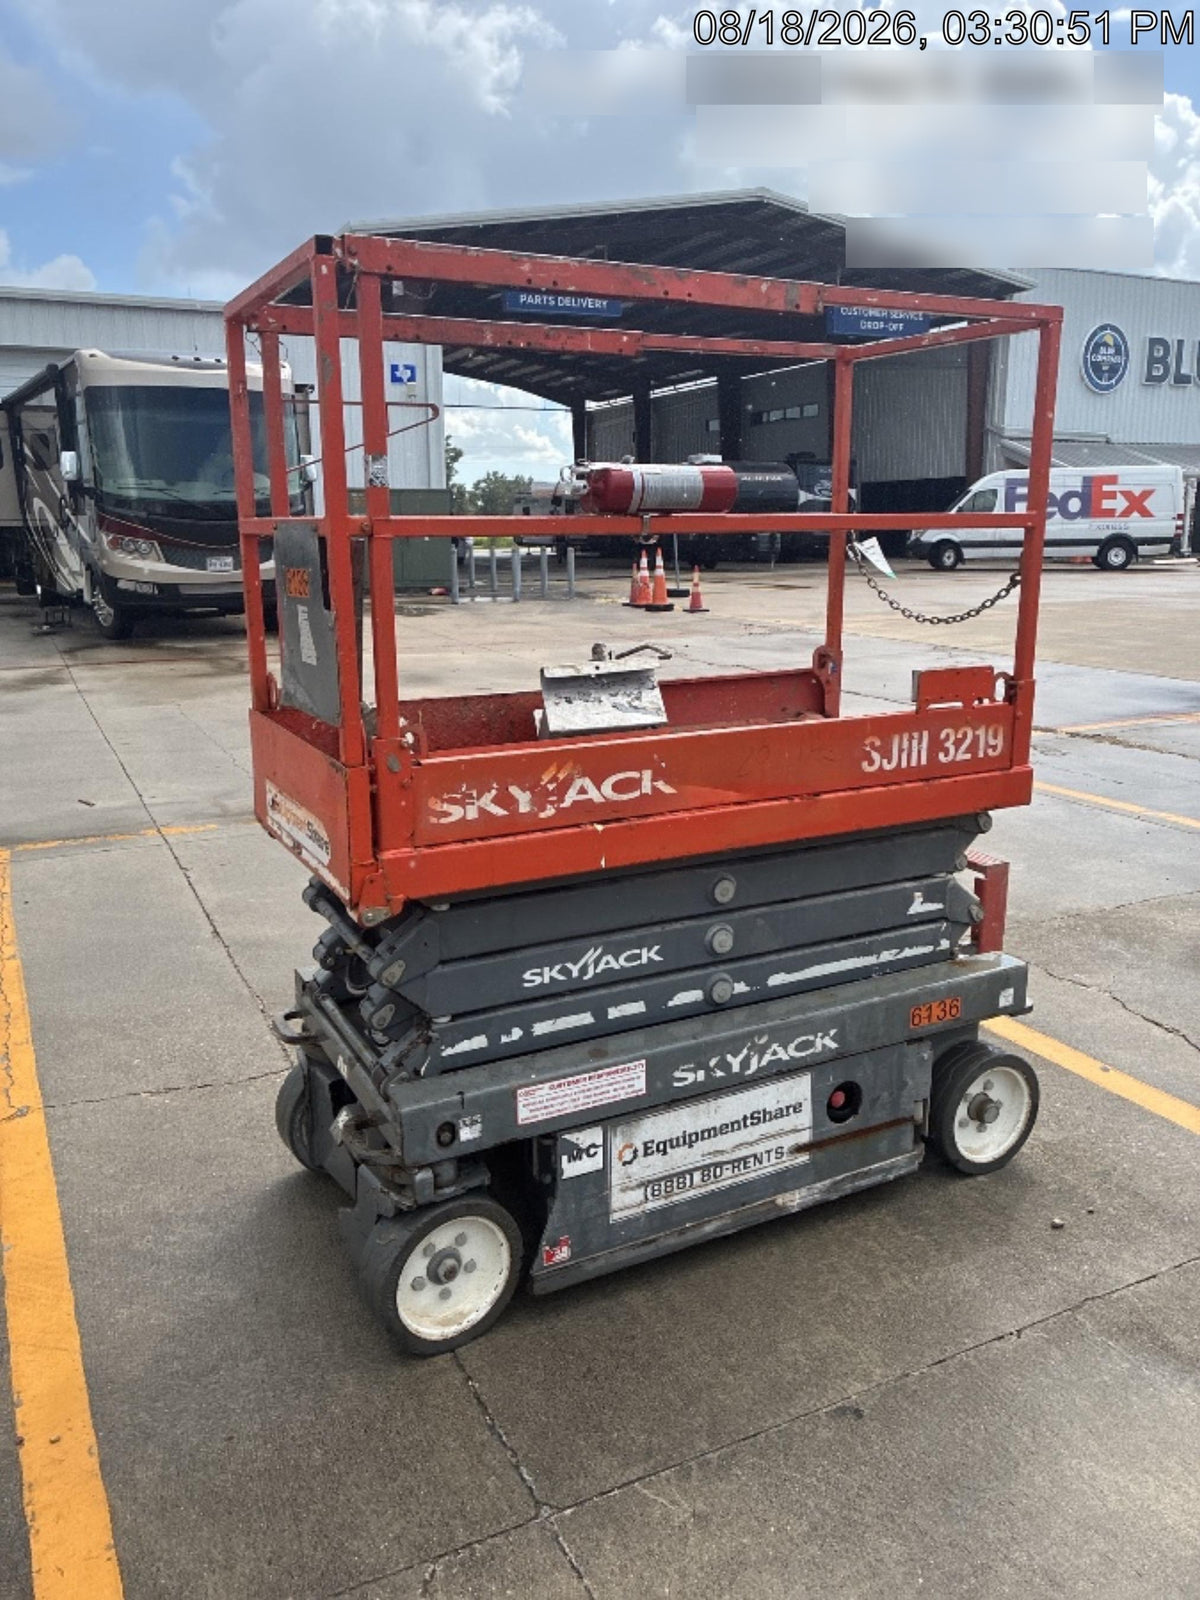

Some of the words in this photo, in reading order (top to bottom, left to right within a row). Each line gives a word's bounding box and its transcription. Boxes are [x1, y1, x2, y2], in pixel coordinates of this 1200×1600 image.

[520, 294, 555, 306] PARTS
[557, 296, 608, 309] DELIVERY
[860, 320, 904, 331] DROP-OFF
[1143, 336, 1200, 385] BL
[938, 724, 1004, 764] 3219
[522, 945, 664, 988] SKYJACK
[672, 1028, 841, 1087] SKYJACK
[641, 1101, 803, 1158] EquipmentShare
[644, 1172, 694, 1201] (888)
[701, 1146, 785, 1183] 80-RENTS
